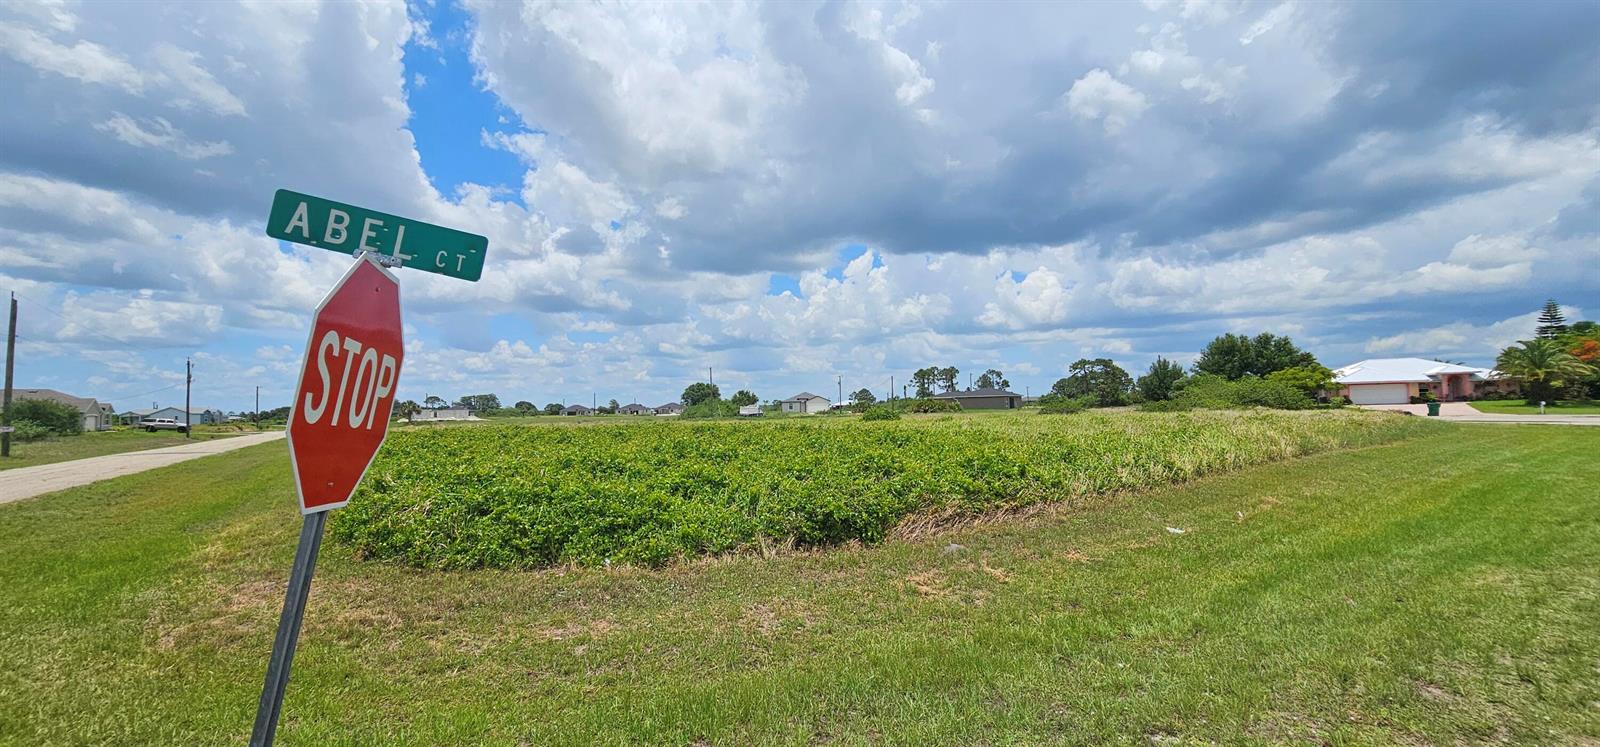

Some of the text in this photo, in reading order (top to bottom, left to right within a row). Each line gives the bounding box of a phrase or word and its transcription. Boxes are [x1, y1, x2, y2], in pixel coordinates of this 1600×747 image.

[284, 201, 465, 271] ABEL CT
[304, 330, 396, 430] STOP
